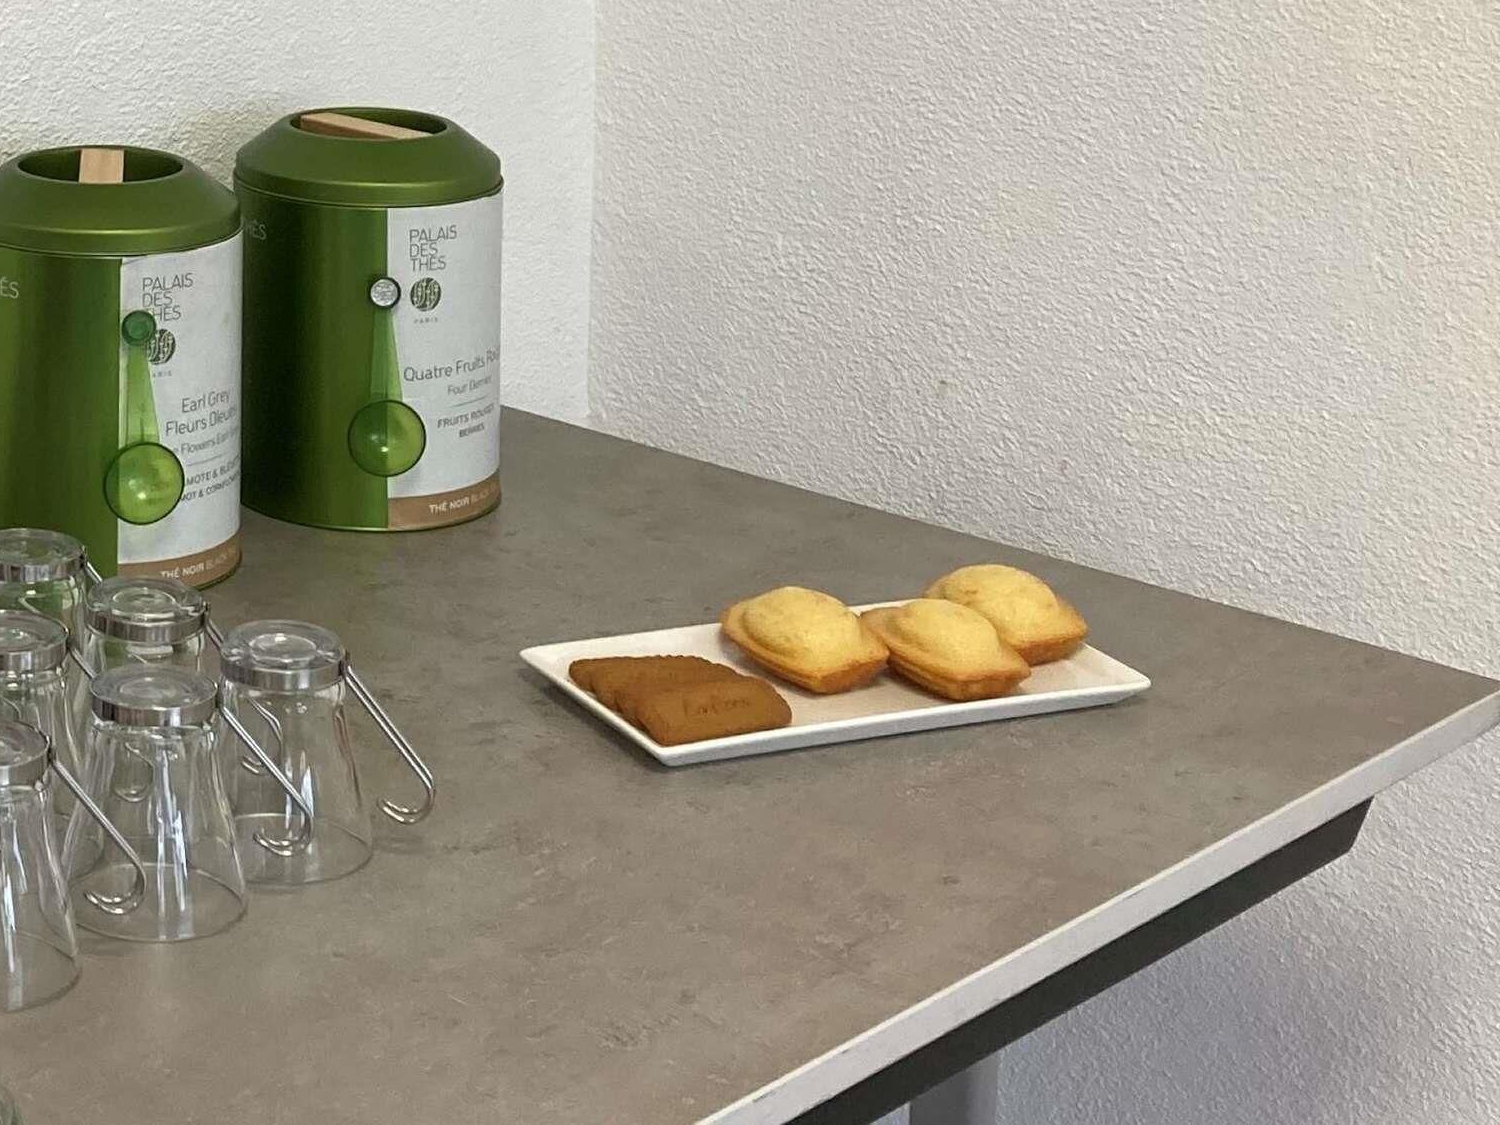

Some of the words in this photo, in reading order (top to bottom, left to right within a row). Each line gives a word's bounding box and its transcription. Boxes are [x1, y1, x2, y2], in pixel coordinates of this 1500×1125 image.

[409, 225, 458, 243] PALAIS
[409, 242, 438, 258] DES
[141, 272, 194, 292] PALAIS
[141, 291, 174, 308] DES
[403, 365, 453, 382] Quatre
[455, 356, 485, 375] Fruits
[181, 394, 206, 414] Earl
[164, 417, 208, 436] Fleurs
[437, 413, 469, 429] FRUITS
[449, 495, 470, 510] NOIR
[181, 562, 205, 576] NOIR
